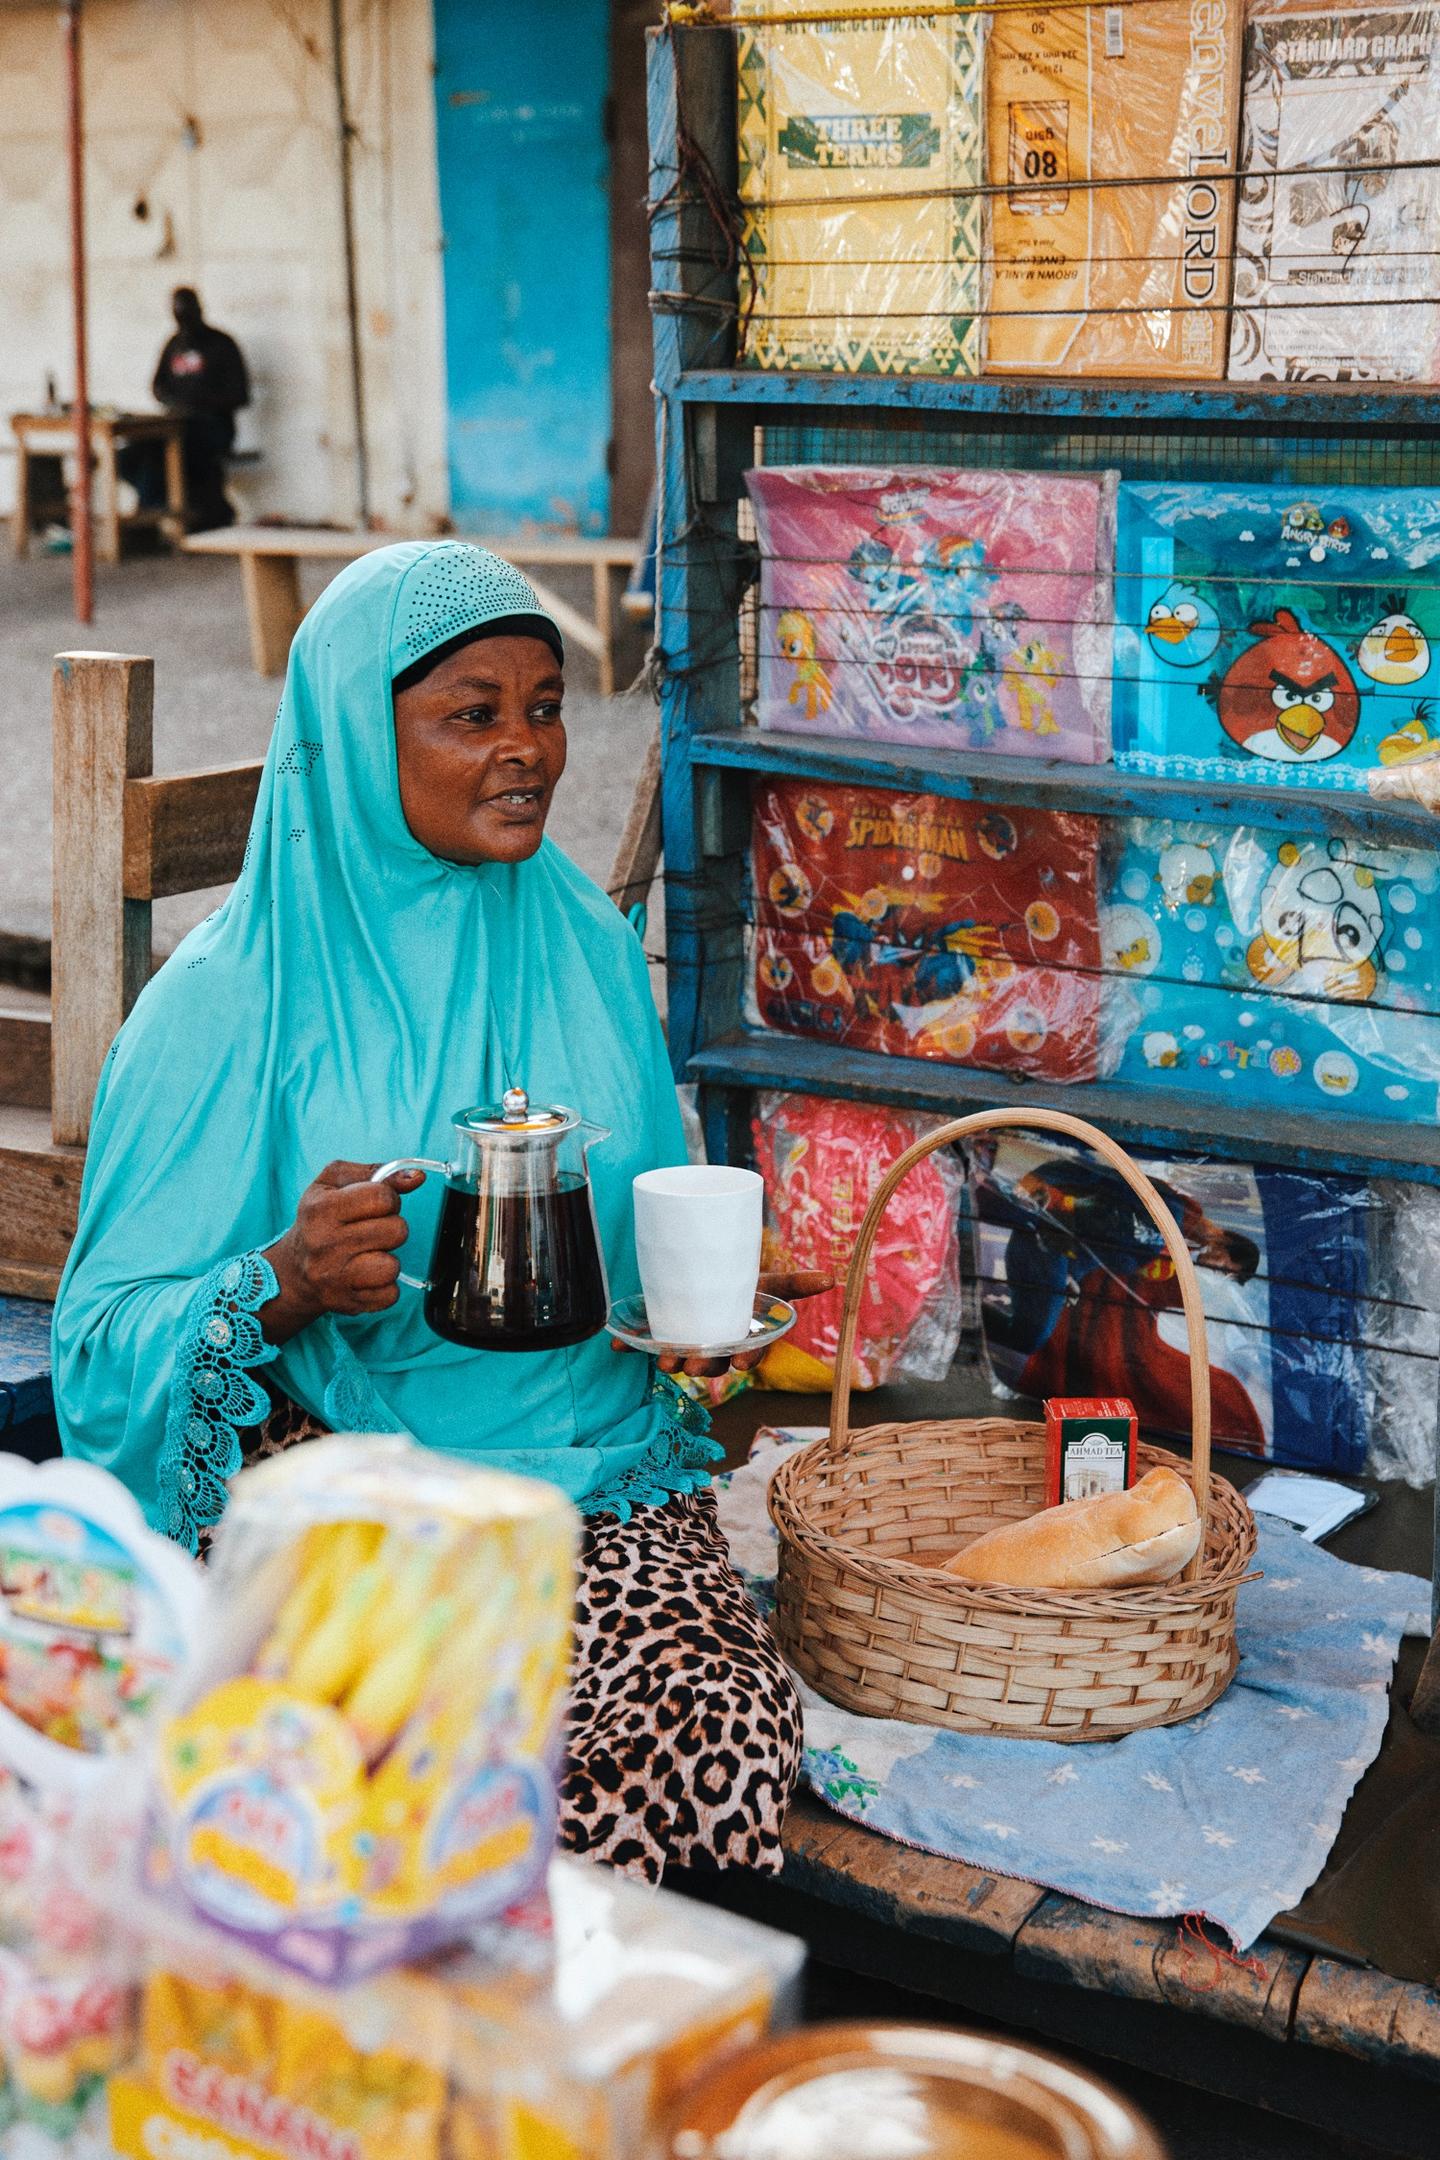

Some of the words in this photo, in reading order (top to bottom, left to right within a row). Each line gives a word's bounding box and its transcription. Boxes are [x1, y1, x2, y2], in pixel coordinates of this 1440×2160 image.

[1031, 22, 1045, 34] 50
[1272, 36, 1368, 64] STANDARD
[814, 118, 902, 142] THREE
[814, 143, 902, 165] TERMS
[1024, 150, 1057, 179] 80
[1037, 270, 1078, 280] BROWN
[1281, 525, 1318, 549] ANGRY
[1070, 1447, 1103, 1456] AHMAD
[1105, 1447, 1121, 1456] TEA
